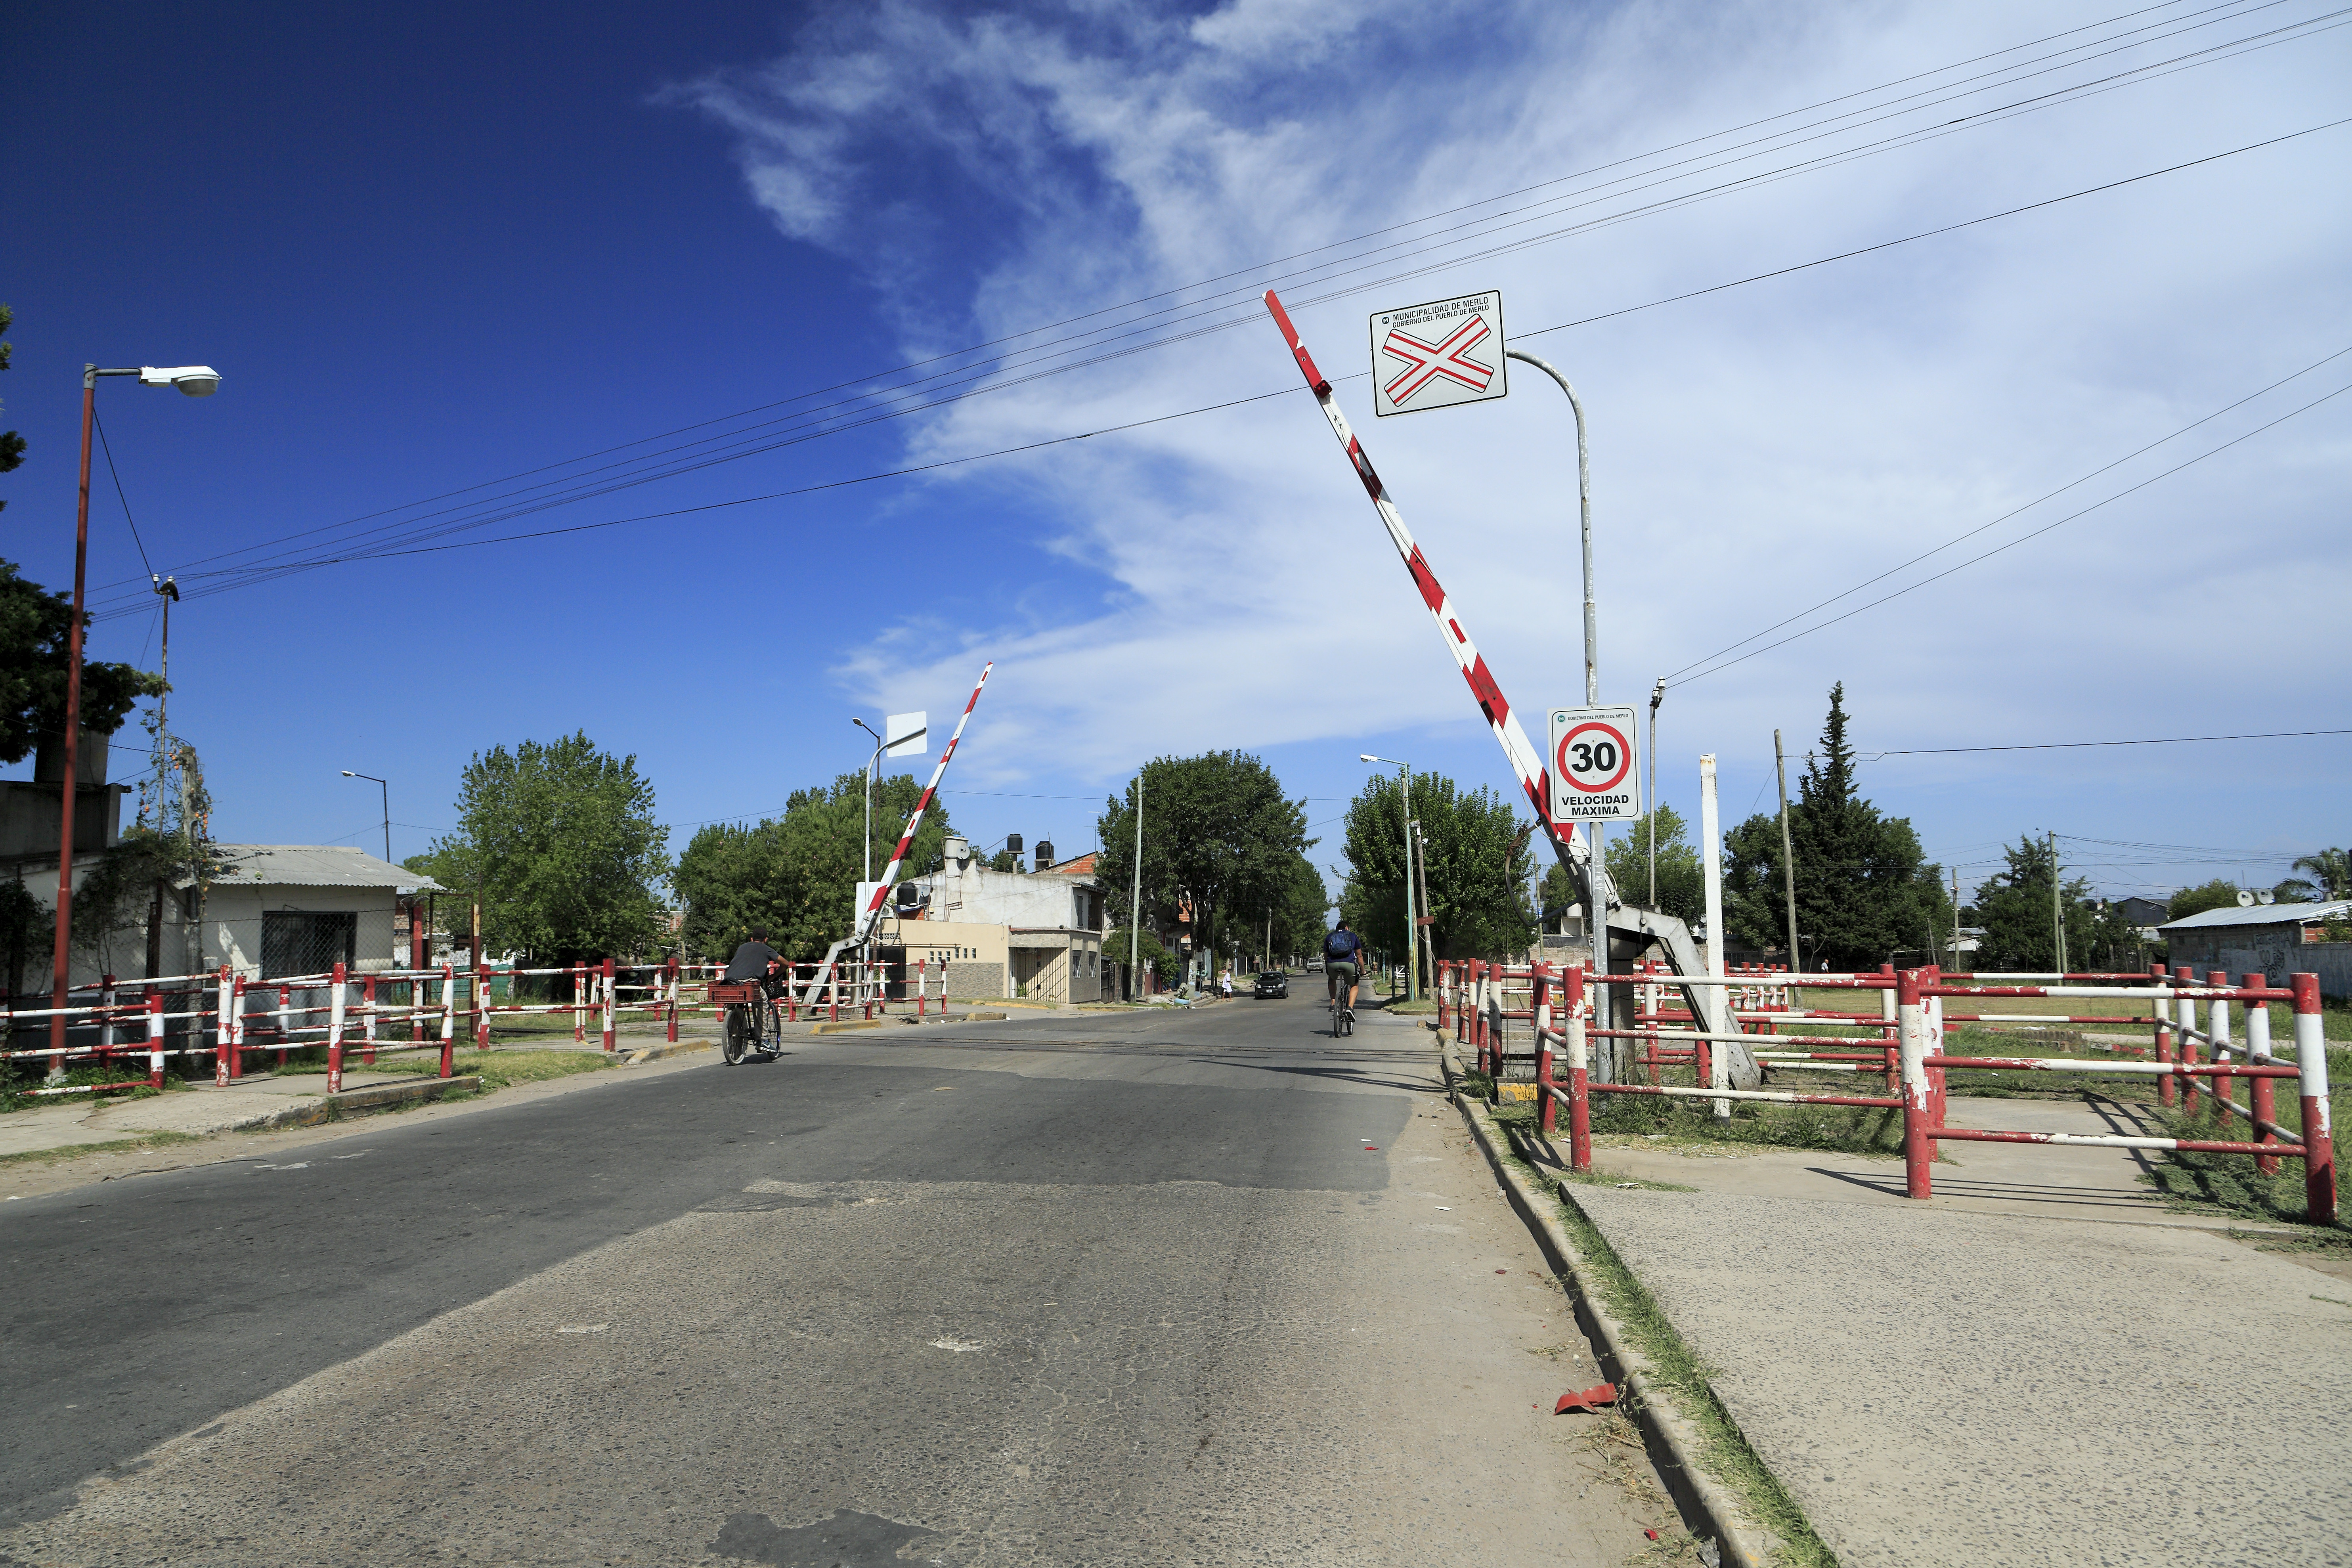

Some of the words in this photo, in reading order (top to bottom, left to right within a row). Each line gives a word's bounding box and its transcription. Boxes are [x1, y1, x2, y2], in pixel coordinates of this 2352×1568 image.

[1392, 317, 1421, 328] GOBIERNO
[1435, 310, 1458, 320] PUEBLO
[1469, 304, 1489, 314] MERLO
[1393, 304, 1449, 321] MUNICIPALIDAD
[1451, 302, 1461, 310] DE
[1463, 296, 1488, 308] MERLO
[1571, 742, 1616, 772] 30
[1561, 795, 1629, 805] VELOCIDAD
[1572, 806, 1620, 816] MAXIMA
